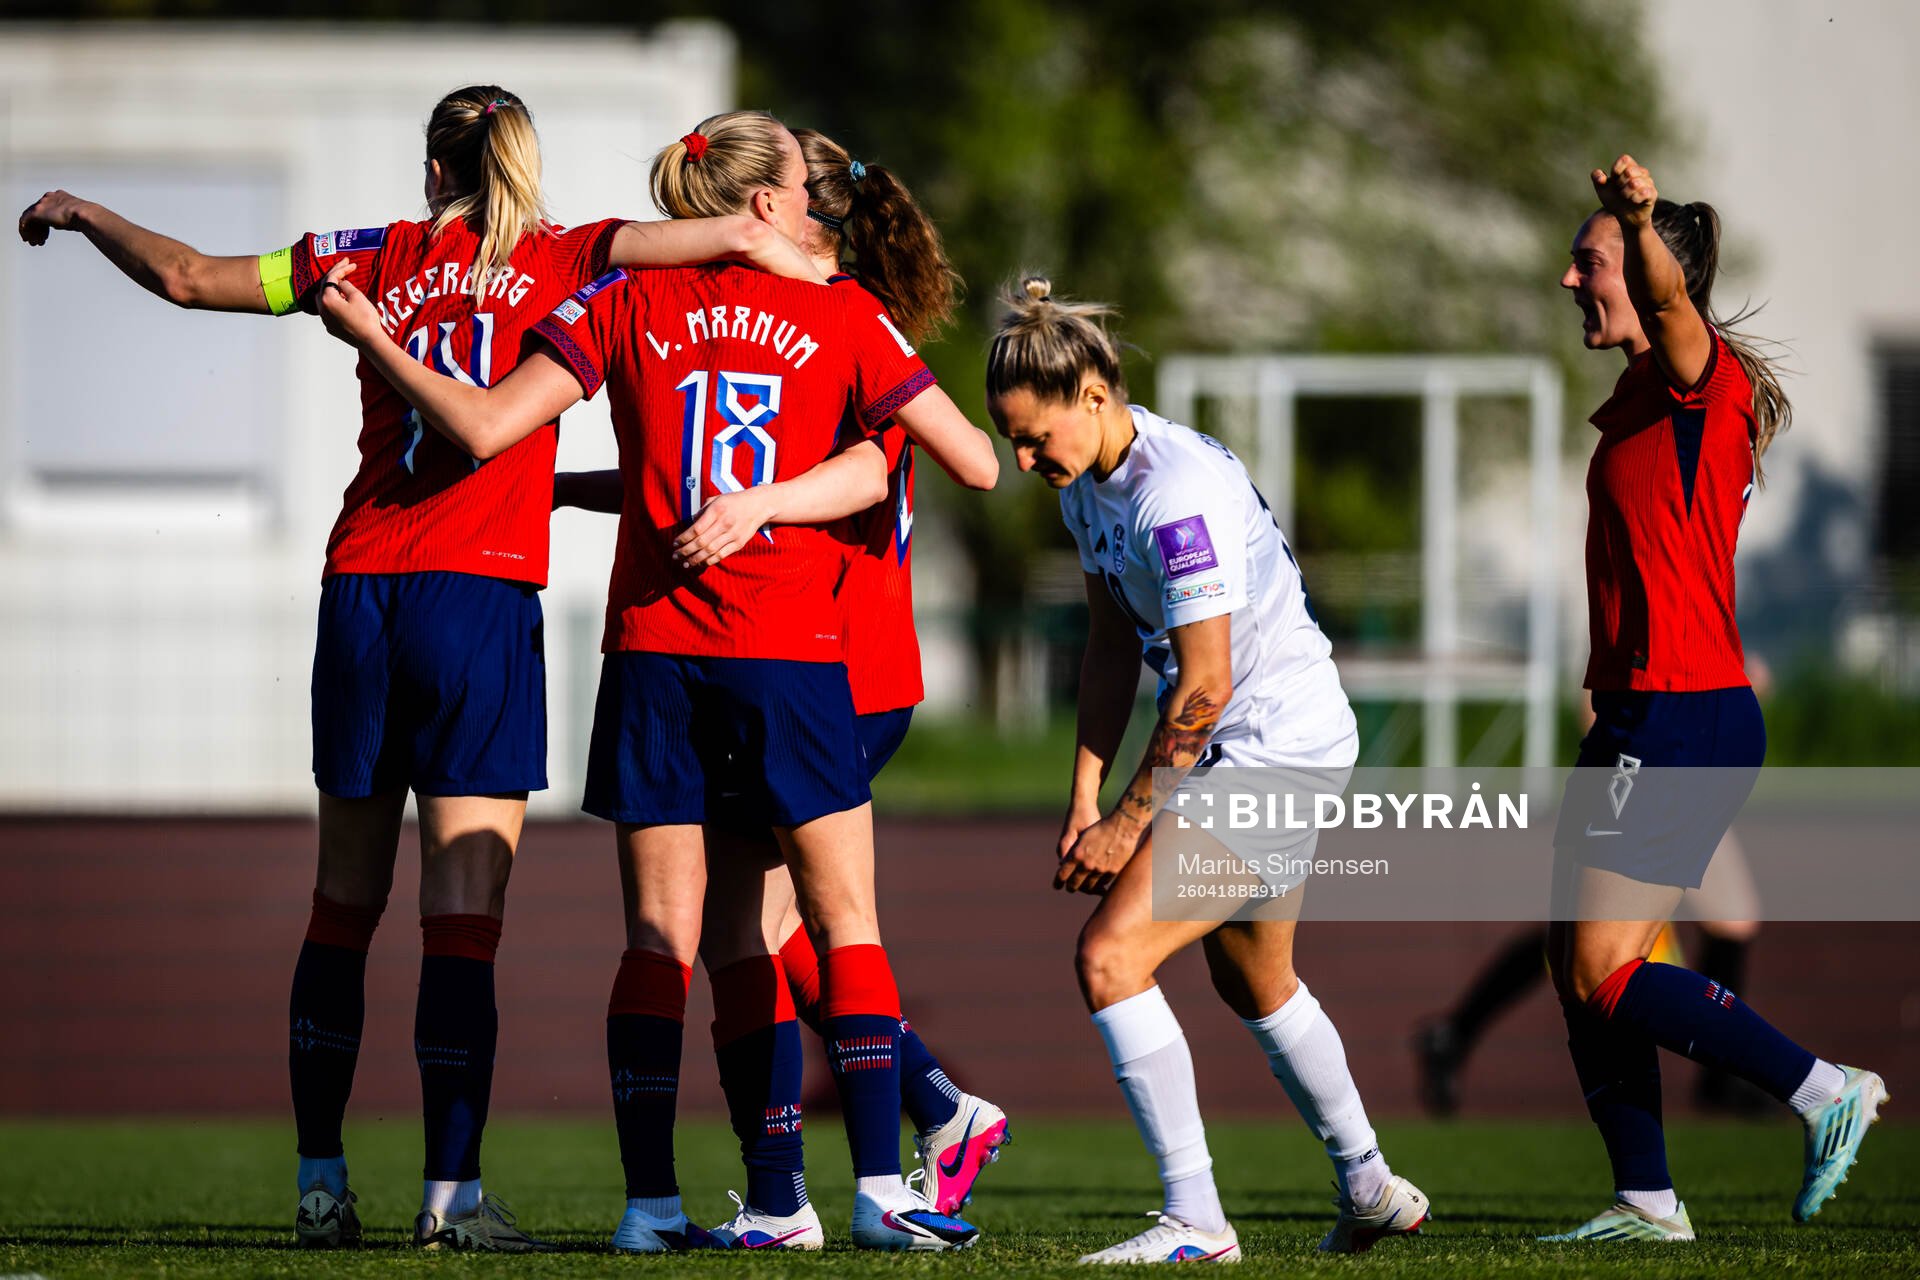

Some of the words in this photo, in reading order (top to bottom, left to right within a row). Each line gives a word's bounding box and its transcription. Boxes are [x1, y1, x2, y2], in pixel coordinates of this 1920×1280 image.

[674, 370, 783, 545] 18
[1168, 549, 1210, 566] EUROPEAN
[1169, 555, 1213, 572] QUALIFIERS
